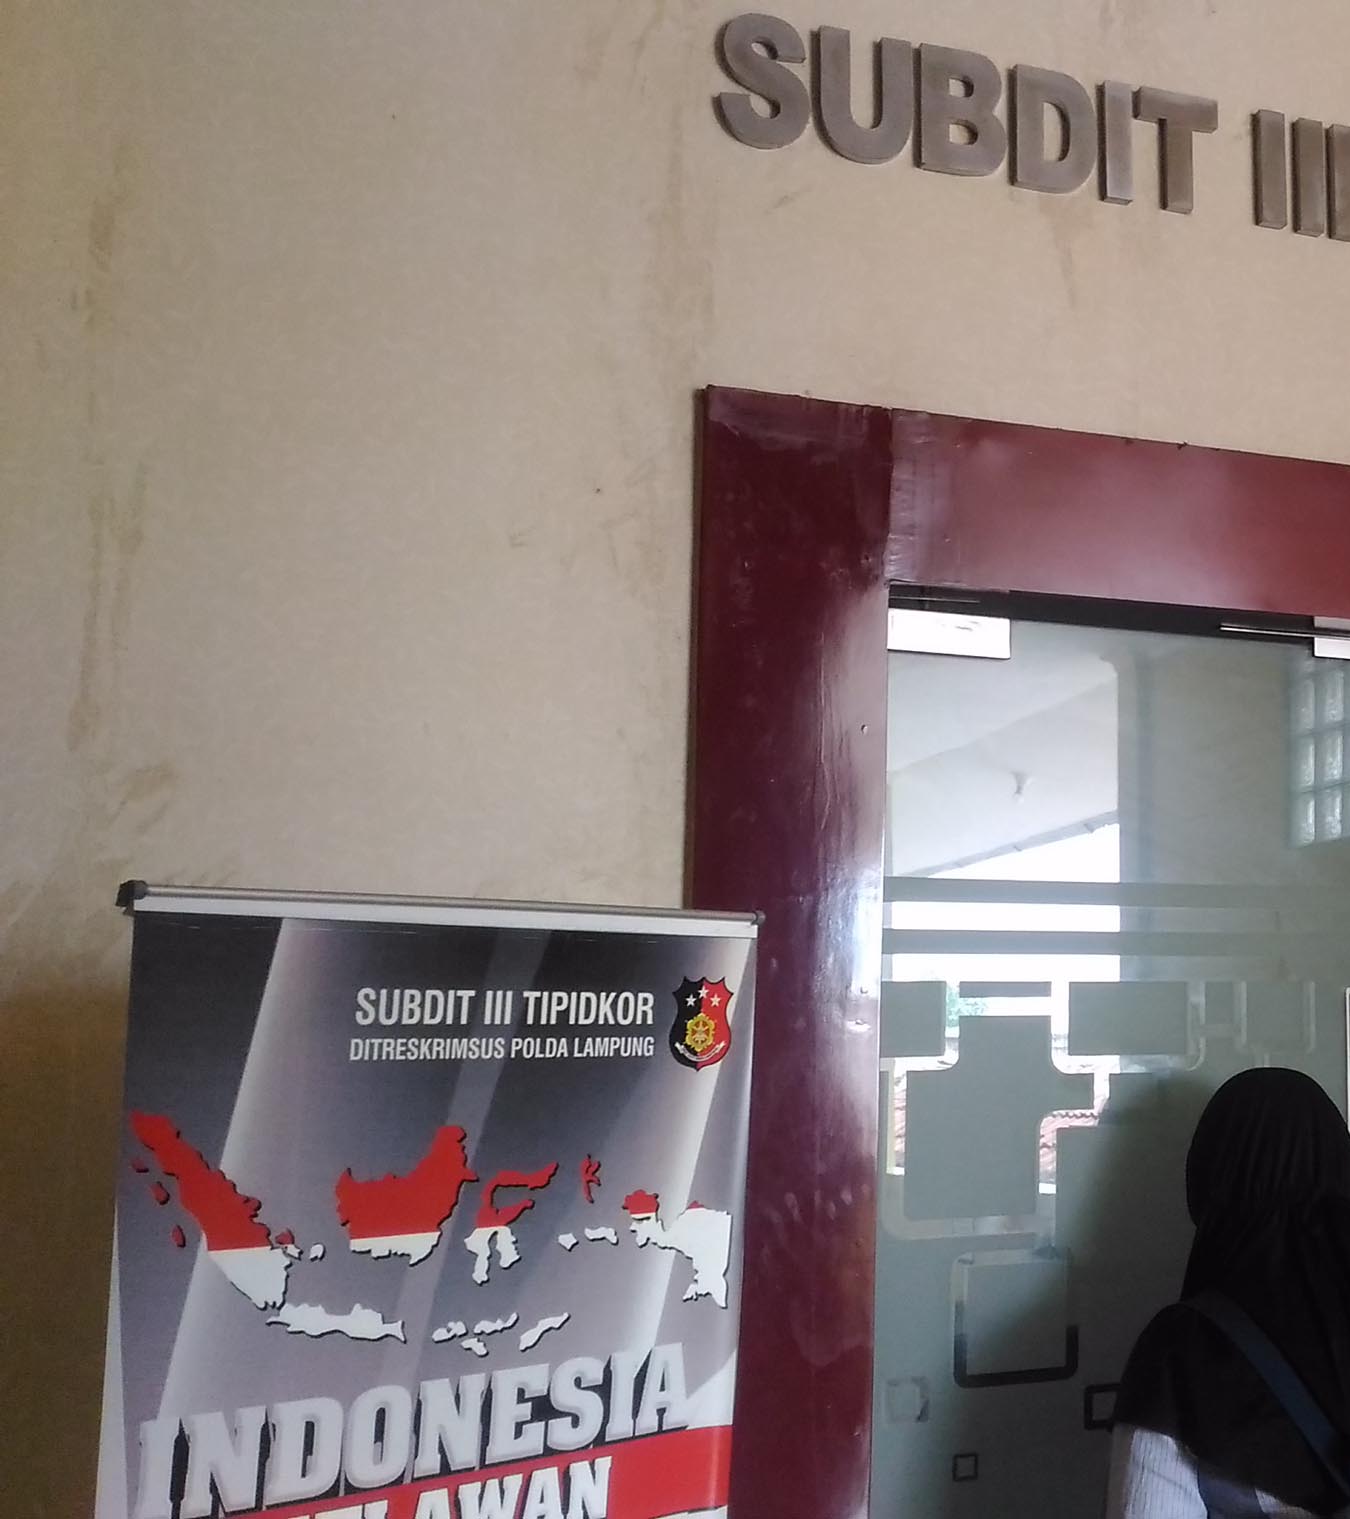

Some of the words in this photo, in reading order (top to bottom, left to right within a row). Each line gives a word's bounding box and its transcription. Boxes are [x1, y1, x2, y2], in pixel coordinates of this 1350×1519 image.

[714, 12, 1219, 215] SUBDIT
[349, 1036, 505, 1061] DITRESKRIMSUS
[510, 1036, 569, 1059] POLDA
[573, 1036, 655, 1058] LAMPUNG
[355, 987, 475, 1027] SUBDIT
[483, 990, 513, 1026] III
[523, 990, 655, 1026] TIPIDKOR
[134, 1343, 688, 1519] INDONESIA
